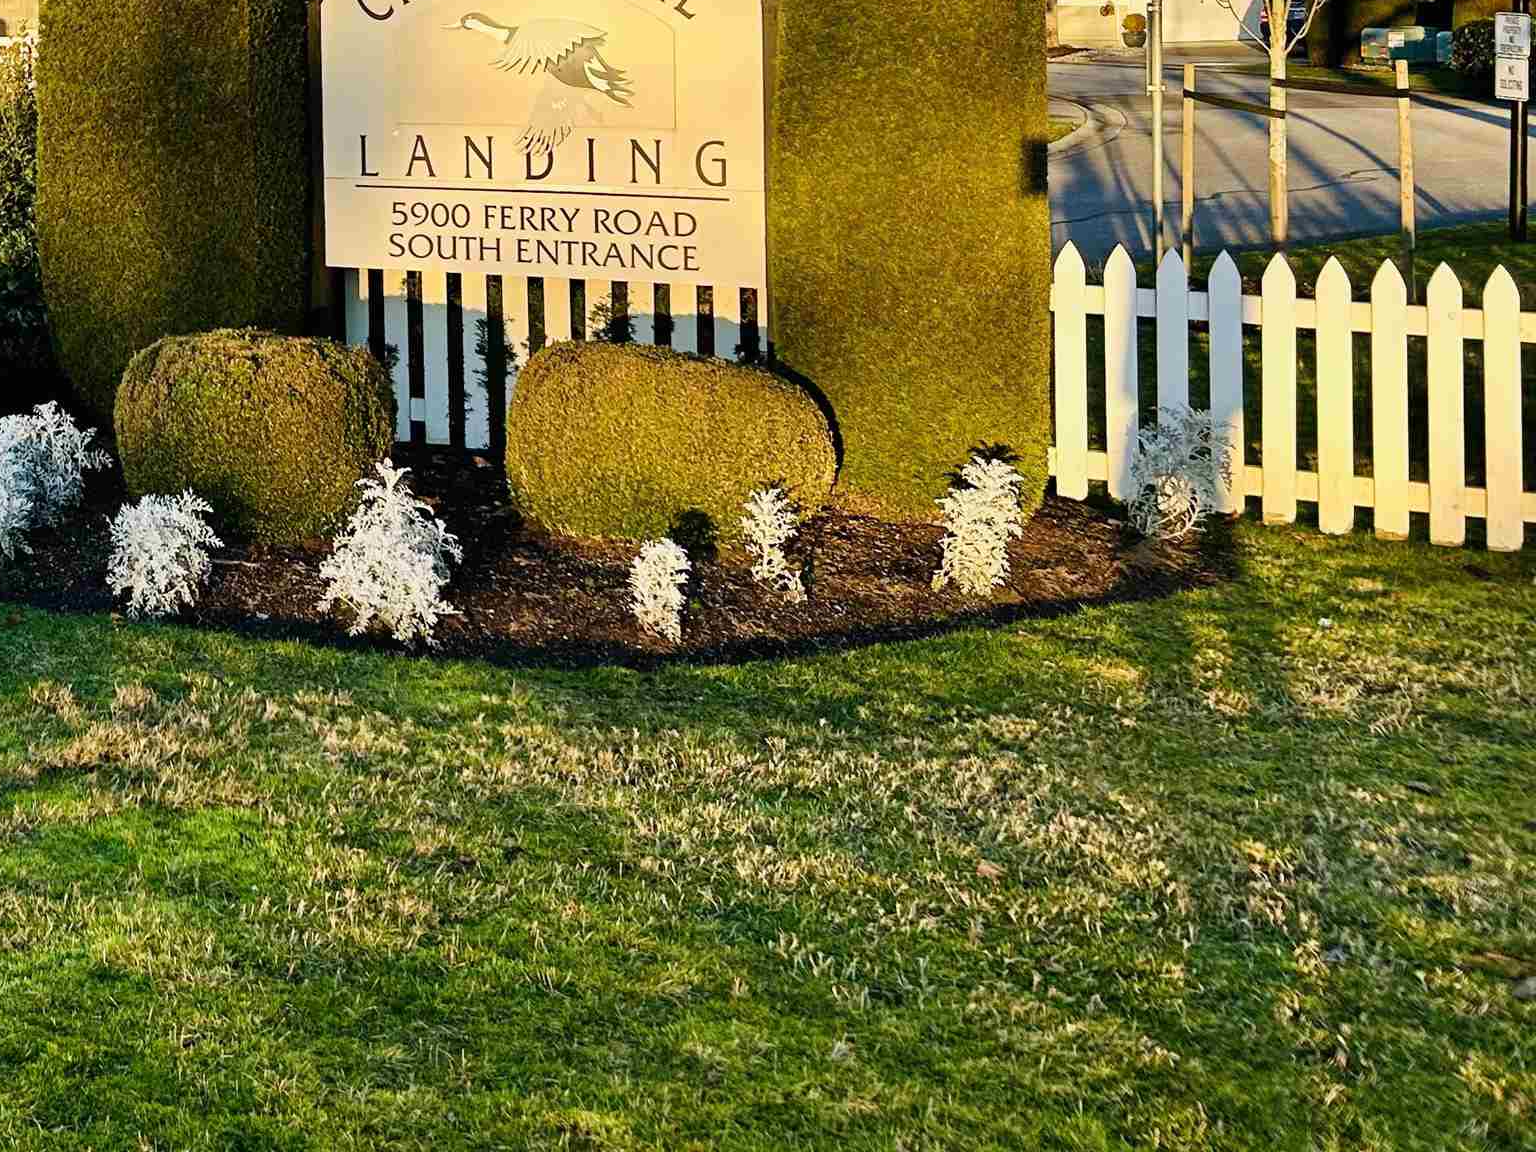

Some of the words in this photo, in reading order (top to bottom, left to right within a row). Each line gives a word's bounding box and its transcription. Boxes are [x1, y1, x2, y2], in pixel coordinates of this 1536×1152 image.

[359, 134, 728, 188] LANDING
[391, 201, 471, 229] 5900
[483, 204, 581, 233] FERRY
[593, 209, 697, 238] ROAD
[388, 233, 502, 262] SOUTH
[515, 238, 701, 272] ENTRANCE
